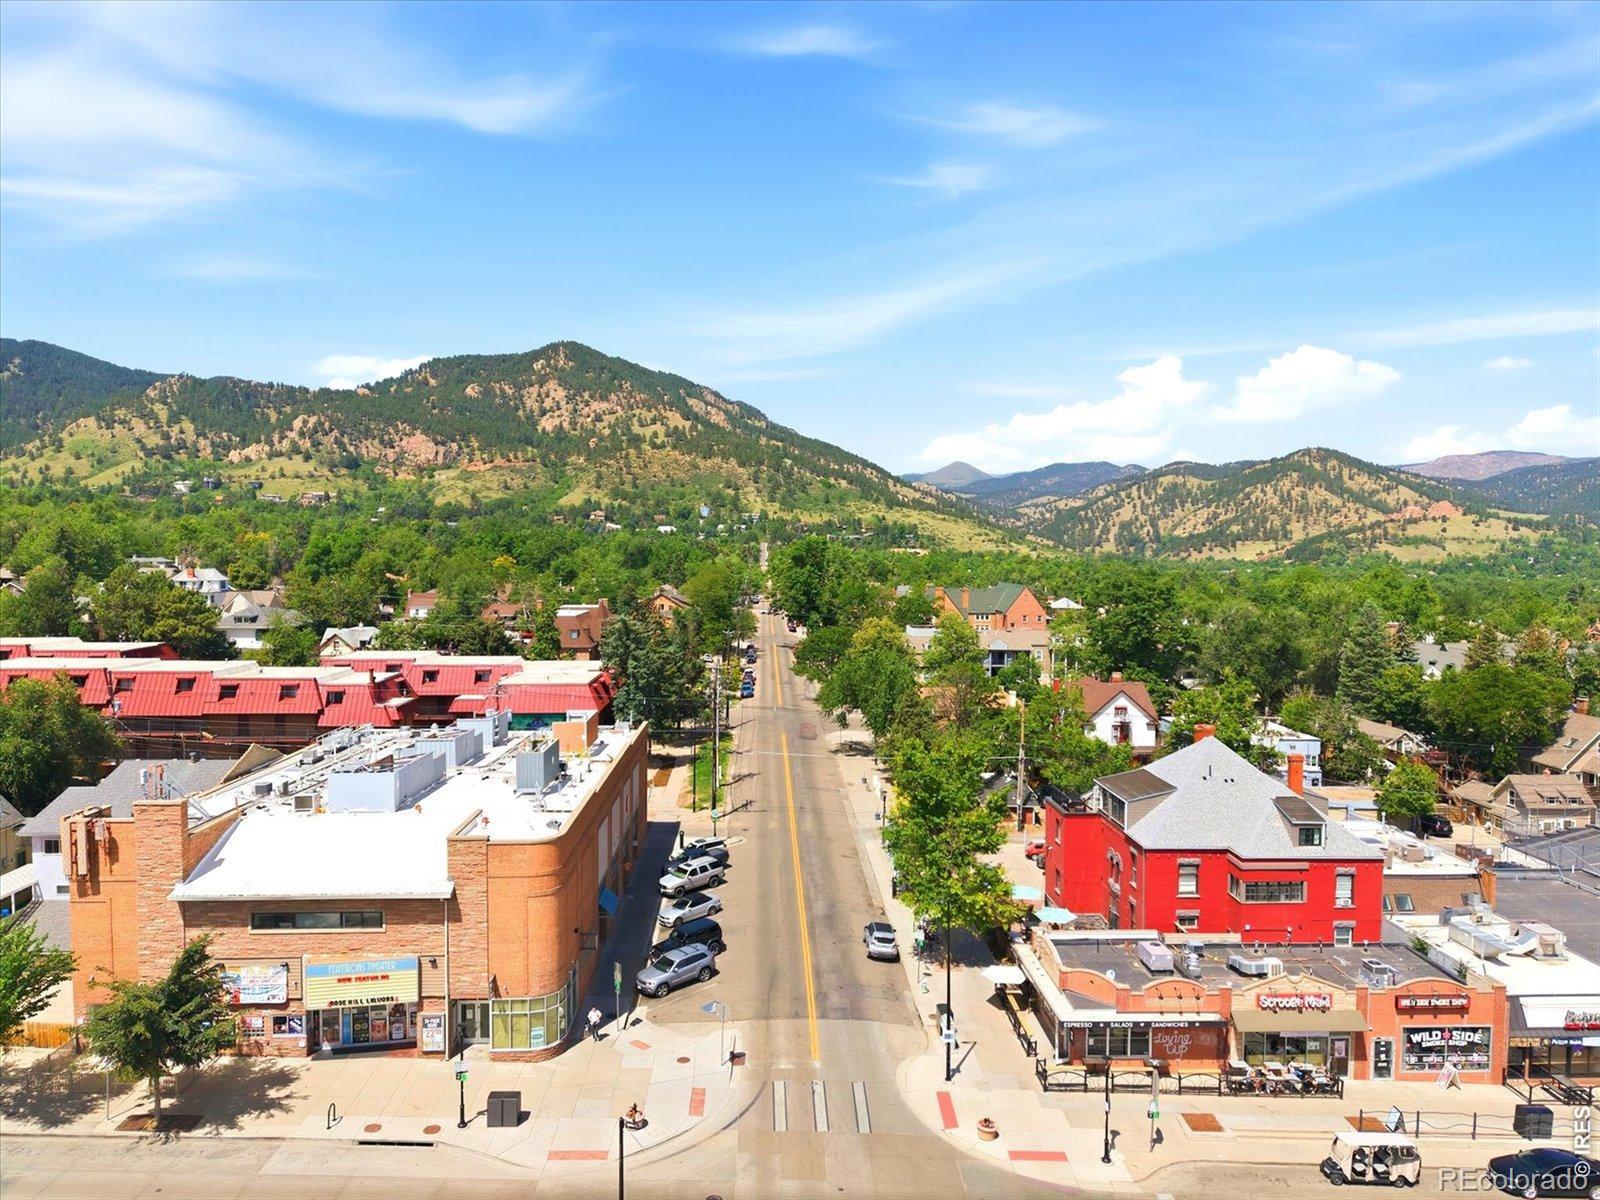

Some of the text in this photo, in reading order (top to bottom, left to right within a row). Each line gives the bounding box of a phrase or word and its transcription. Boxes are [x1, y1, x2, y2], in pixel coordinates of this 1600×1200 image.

[1153, 1031, 1192, 1045] Loving
[1410, 1031, 1483, 1043] WILD SIDE
